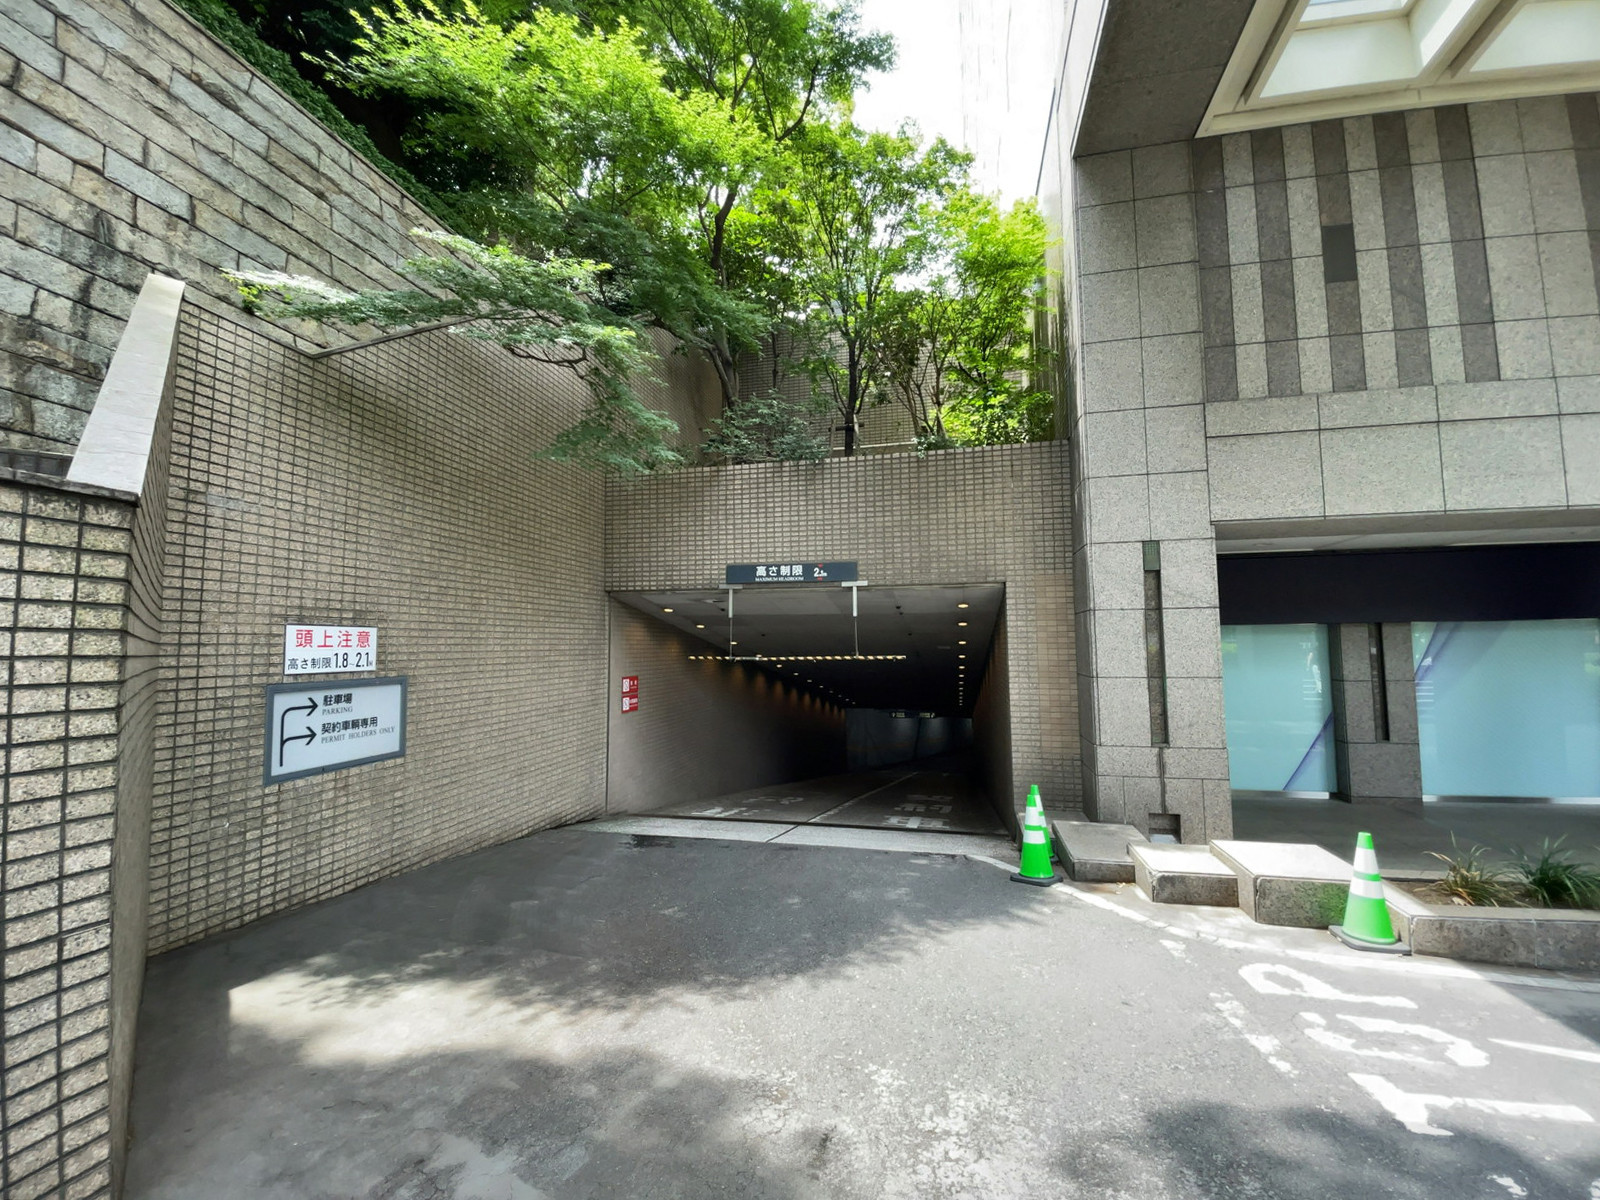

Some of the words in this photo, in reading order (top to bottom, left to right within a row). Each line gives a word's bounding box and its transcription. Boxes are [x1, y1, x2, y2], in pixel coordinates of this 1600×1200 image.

[756, 565, 803, 576] 高さ制限
[296, 629, 371, 648] 頭上注意
[322, 693, 353, 707] 駐車場
[322, 706, 353, 716] PARKING
[321, 733, 346, 745] PERMIT
[348, 729, 377, 740] HOLDERS
[378, 726, 396, 735] ONLY
